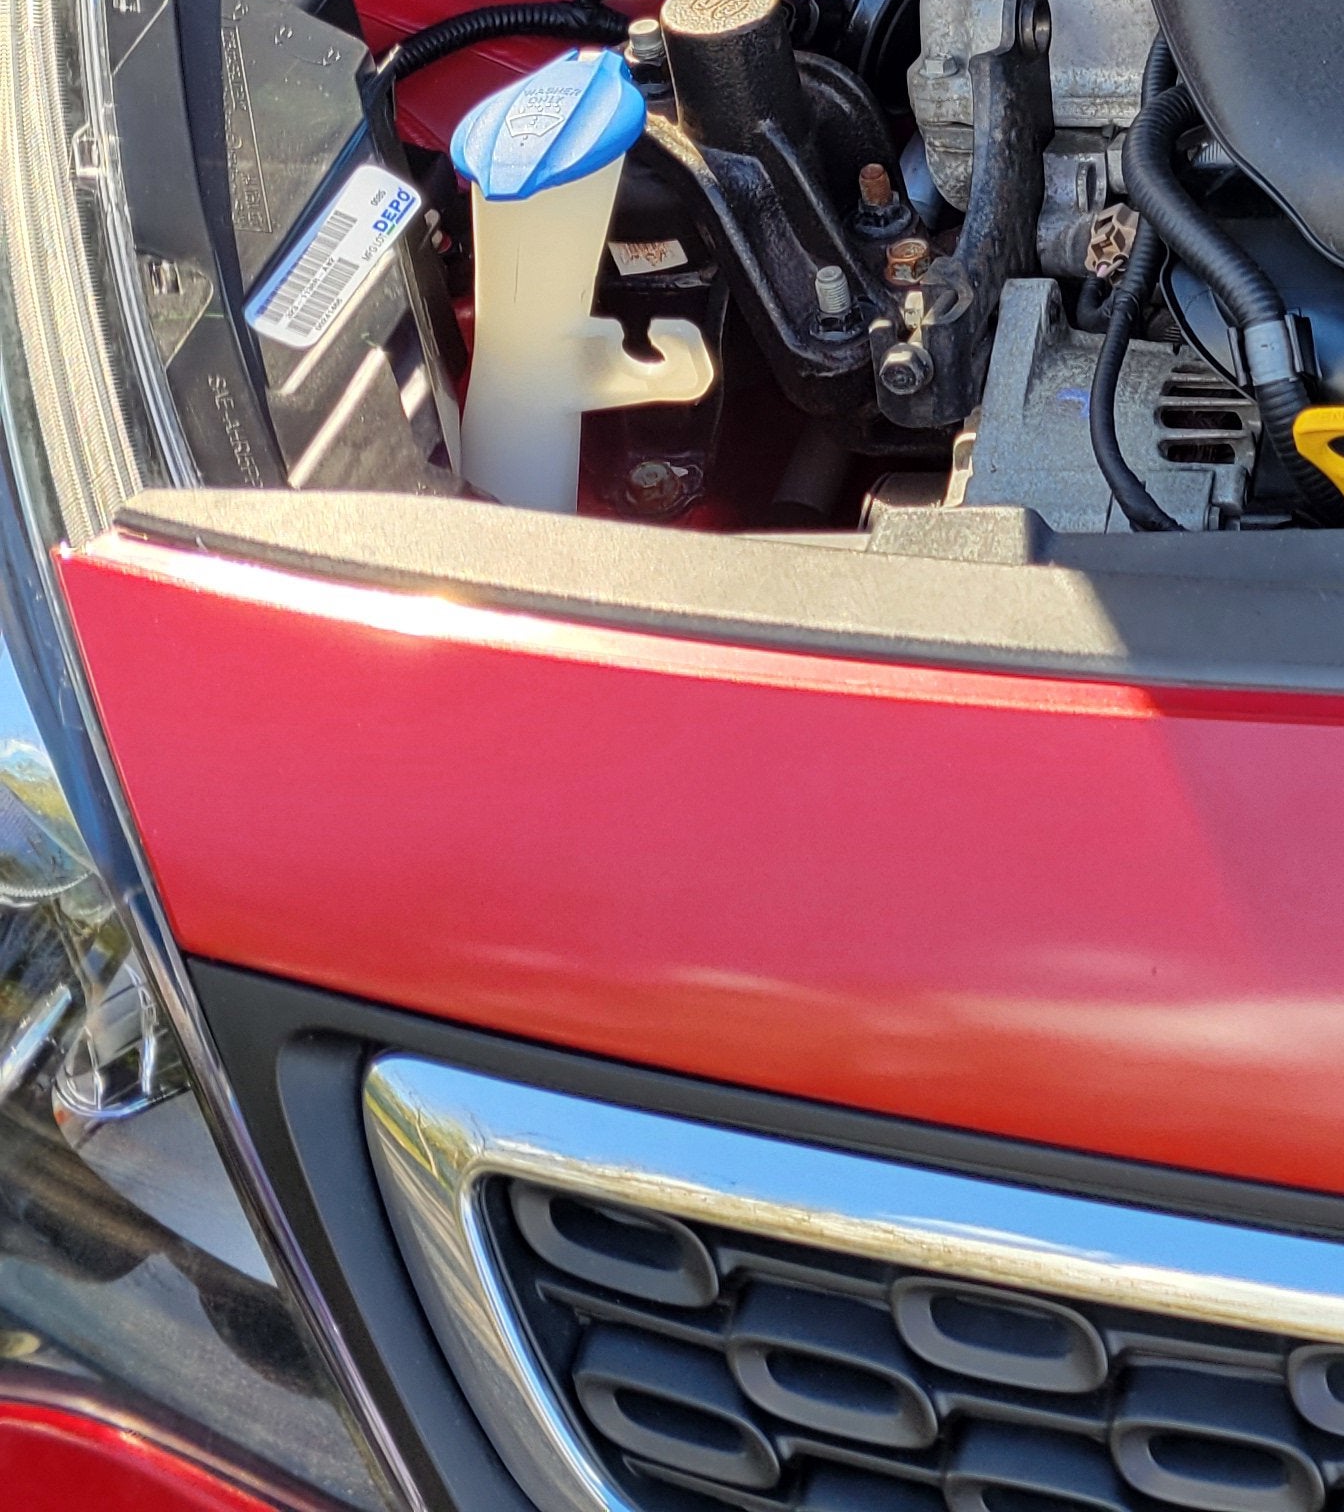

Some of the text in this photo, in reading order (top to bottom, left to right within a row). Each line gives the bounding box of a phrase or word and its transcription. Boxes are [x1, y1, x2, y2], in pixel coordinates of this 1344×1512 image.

[523, 87, 582, 97] WASHER
[527, 95, 565, 104] ONLY
[372, 187, 410, 234] DEPO
